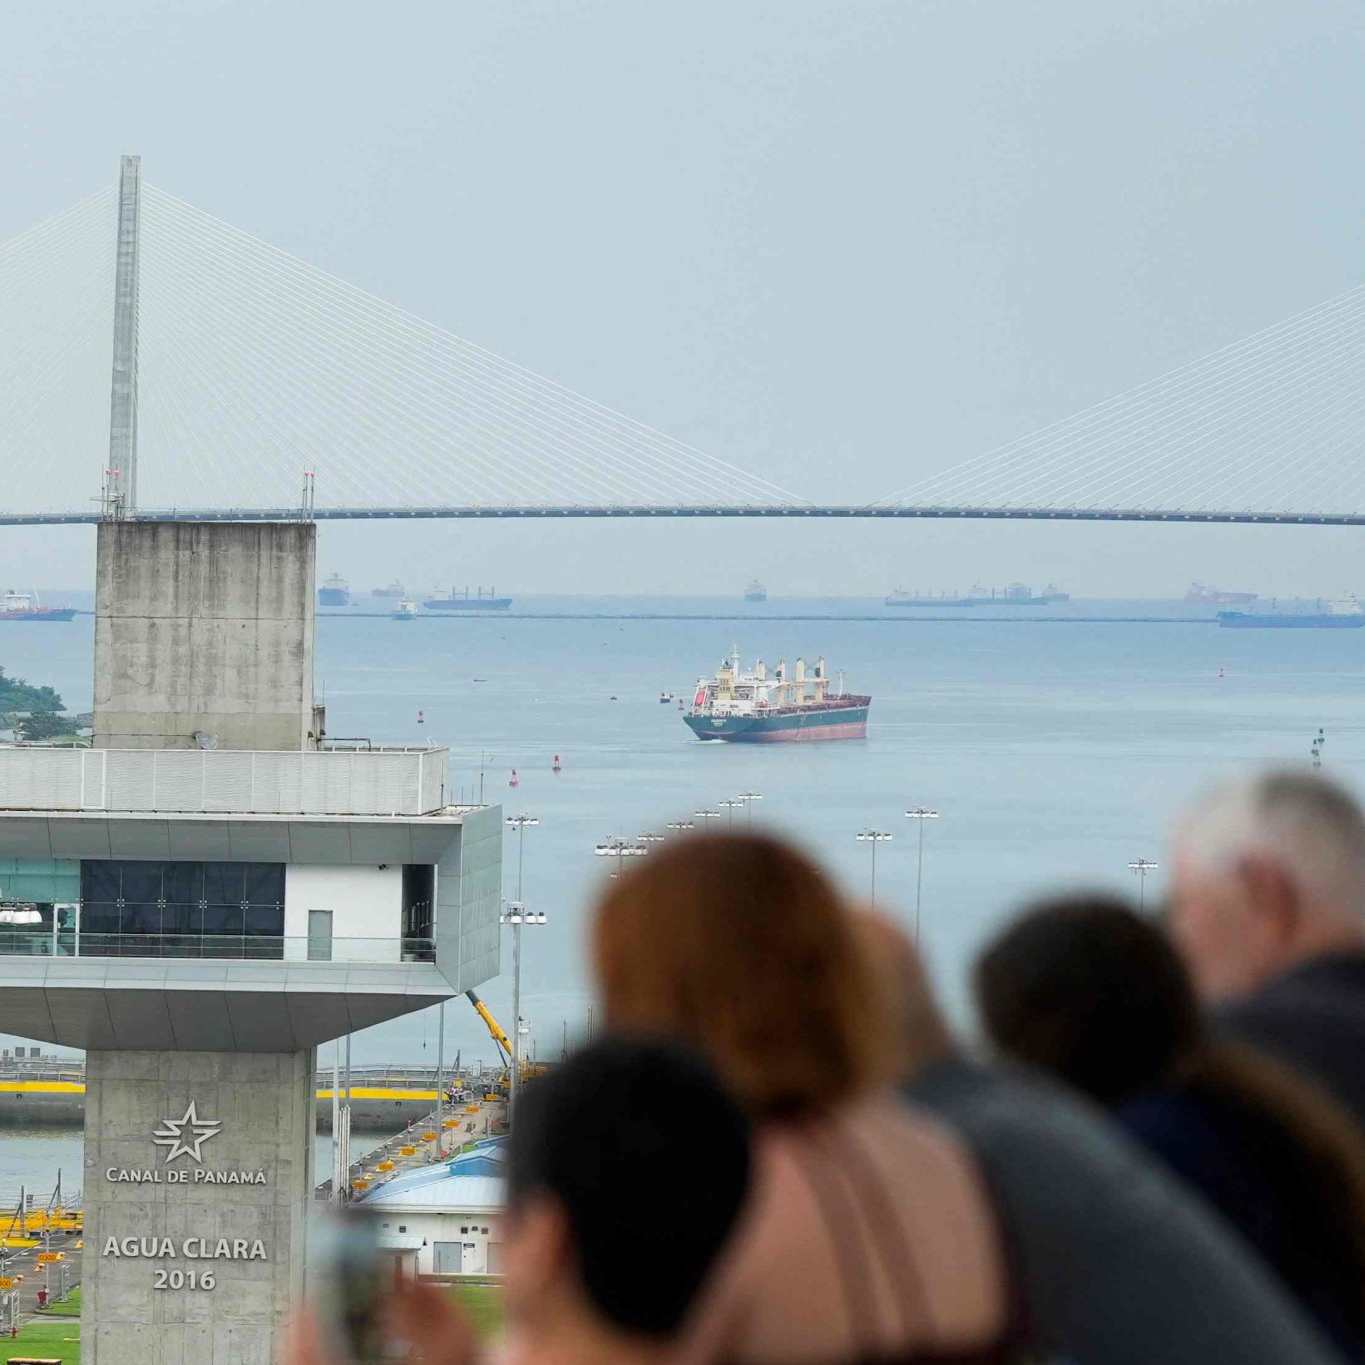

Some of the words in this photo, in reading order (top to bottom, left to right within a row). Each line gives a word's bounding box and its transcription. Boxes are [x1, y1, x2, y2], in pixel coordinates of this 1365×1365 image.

[106, 1167, 162, 1183] CANAL
[167, 1170, 189, 1183] DE
[194, 1167, 267, 1184] PANAMÁ
[102, 1236, 177, 1258] AGUA
[182, 1237, 267, 1260] CLARA
[152, 1269, 216, 1290] 2016
